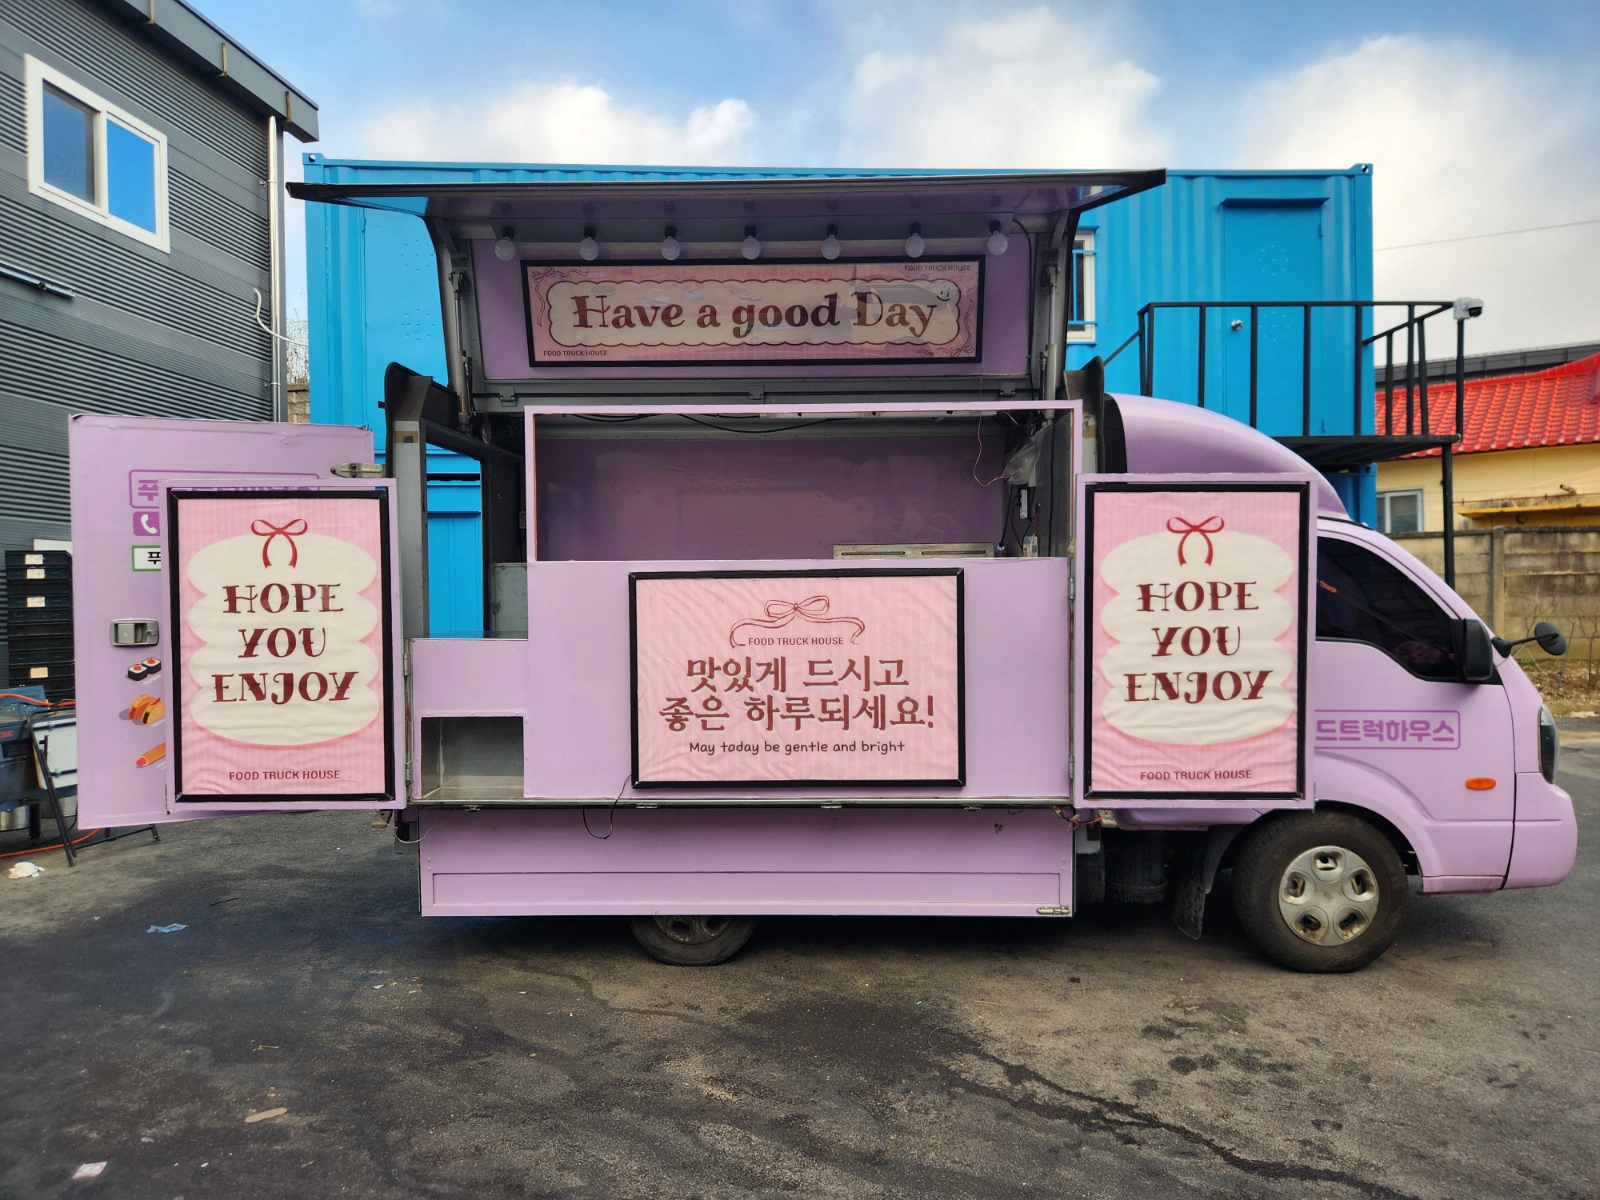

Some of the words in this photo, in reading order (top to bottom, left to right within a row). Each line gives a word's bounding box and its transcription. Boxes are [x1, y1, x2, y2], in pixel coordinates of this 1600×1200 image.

[904, 264, 923, 272] FOOD
[925, 264, 947, 272] TRUCK
[948, 264, 971, 272] HOUSE
[572, 294, 686, 329] Have
[696, 304, 721, 328] a
[732, 292, 841, 338] good
[851, 291, 938, 337] Day
[585, 349, 607, 357] HOUSE
[222, 583, 344, 614] HOPE
[1136, 581, 1260, 612] HOPE
[238, 627, 327, 658] YOU
[748, 637, 774, 646] FOOD
[776, 637, 809, 646] TRUCK
[811, 636, 844, 646] HOUSE
[1151, 626, 1241, 657] YOU
[211, 671, 359, 705] ENJOY
[686, 656, 787, 693] 맛있게
[802, 655, 909, 692] 드시고
[1123, 670, 1274, 704] ENJOY
[659, 695, 730, 732] 좋은
[743, 694, 934, 731] 하루되세요!
[1315, 719, 1455, 742] 드트럭하우스
[689, 741, 715, 755] May
[720, 740, 759, 755] today
[764, 740, 780, 752] be
[784, 740, 828, 755] gentle
[833, 740, 857, 752] and
[861, 740, 905, 755] bright
[229, 771, 260, 781] FOOD
[262, 771, 300, 781] TRUCK
[302, 770, 341, 780] HOUSE
[1140, 770, 1171, 781] FOOD
[1173, 770, 1211, 780] TRUCK
[1213, 769, 1252, 780] HOUSE
